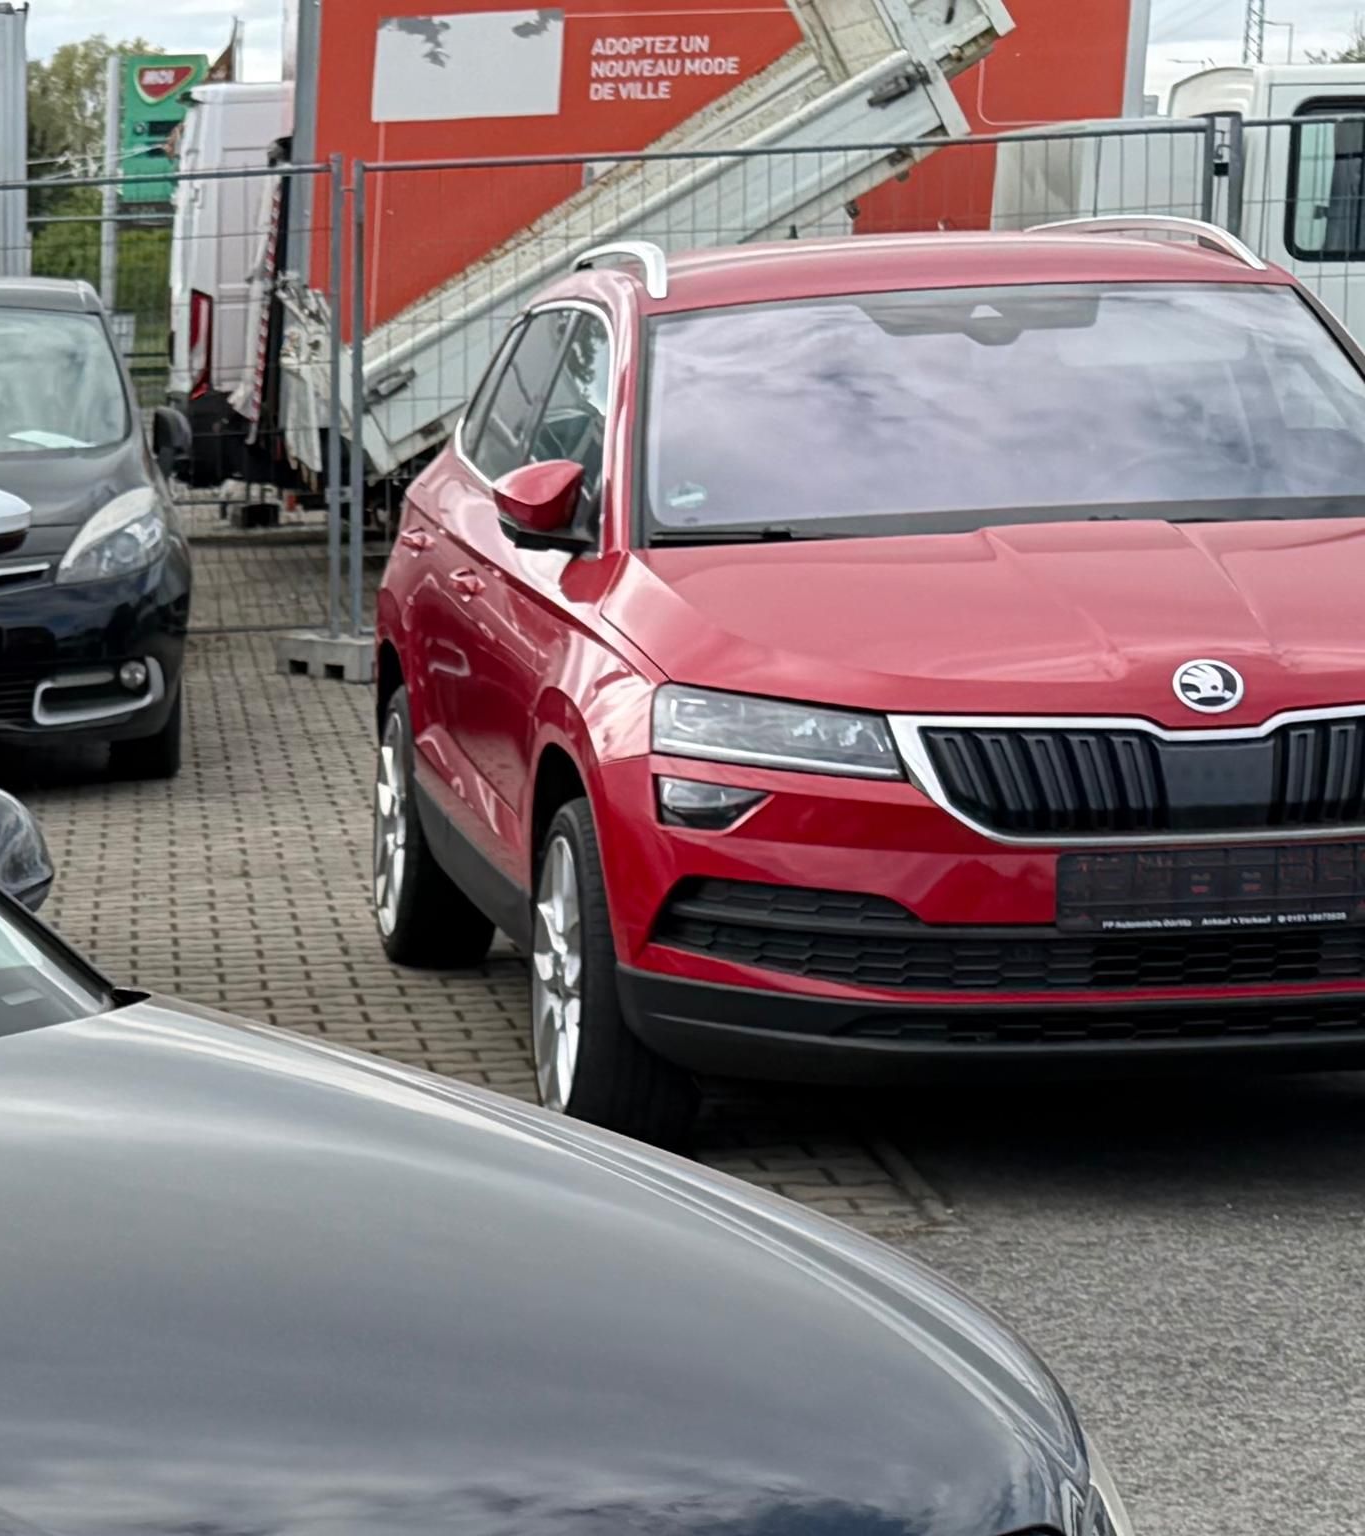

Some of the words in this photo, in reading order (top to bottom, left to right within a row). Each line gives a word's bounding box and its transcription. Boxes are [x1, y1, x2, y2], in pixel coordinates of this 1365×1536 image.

[590, 36, 678, 56] ADOPTEZ
[680, 35, 710, 53] UN
[590, 58, 681, 78] NOUVEAU
[684, 56, 740, 76] MODE
[589, 82, 616, 100] DE
[618, 81, 672, 100] VILLE
